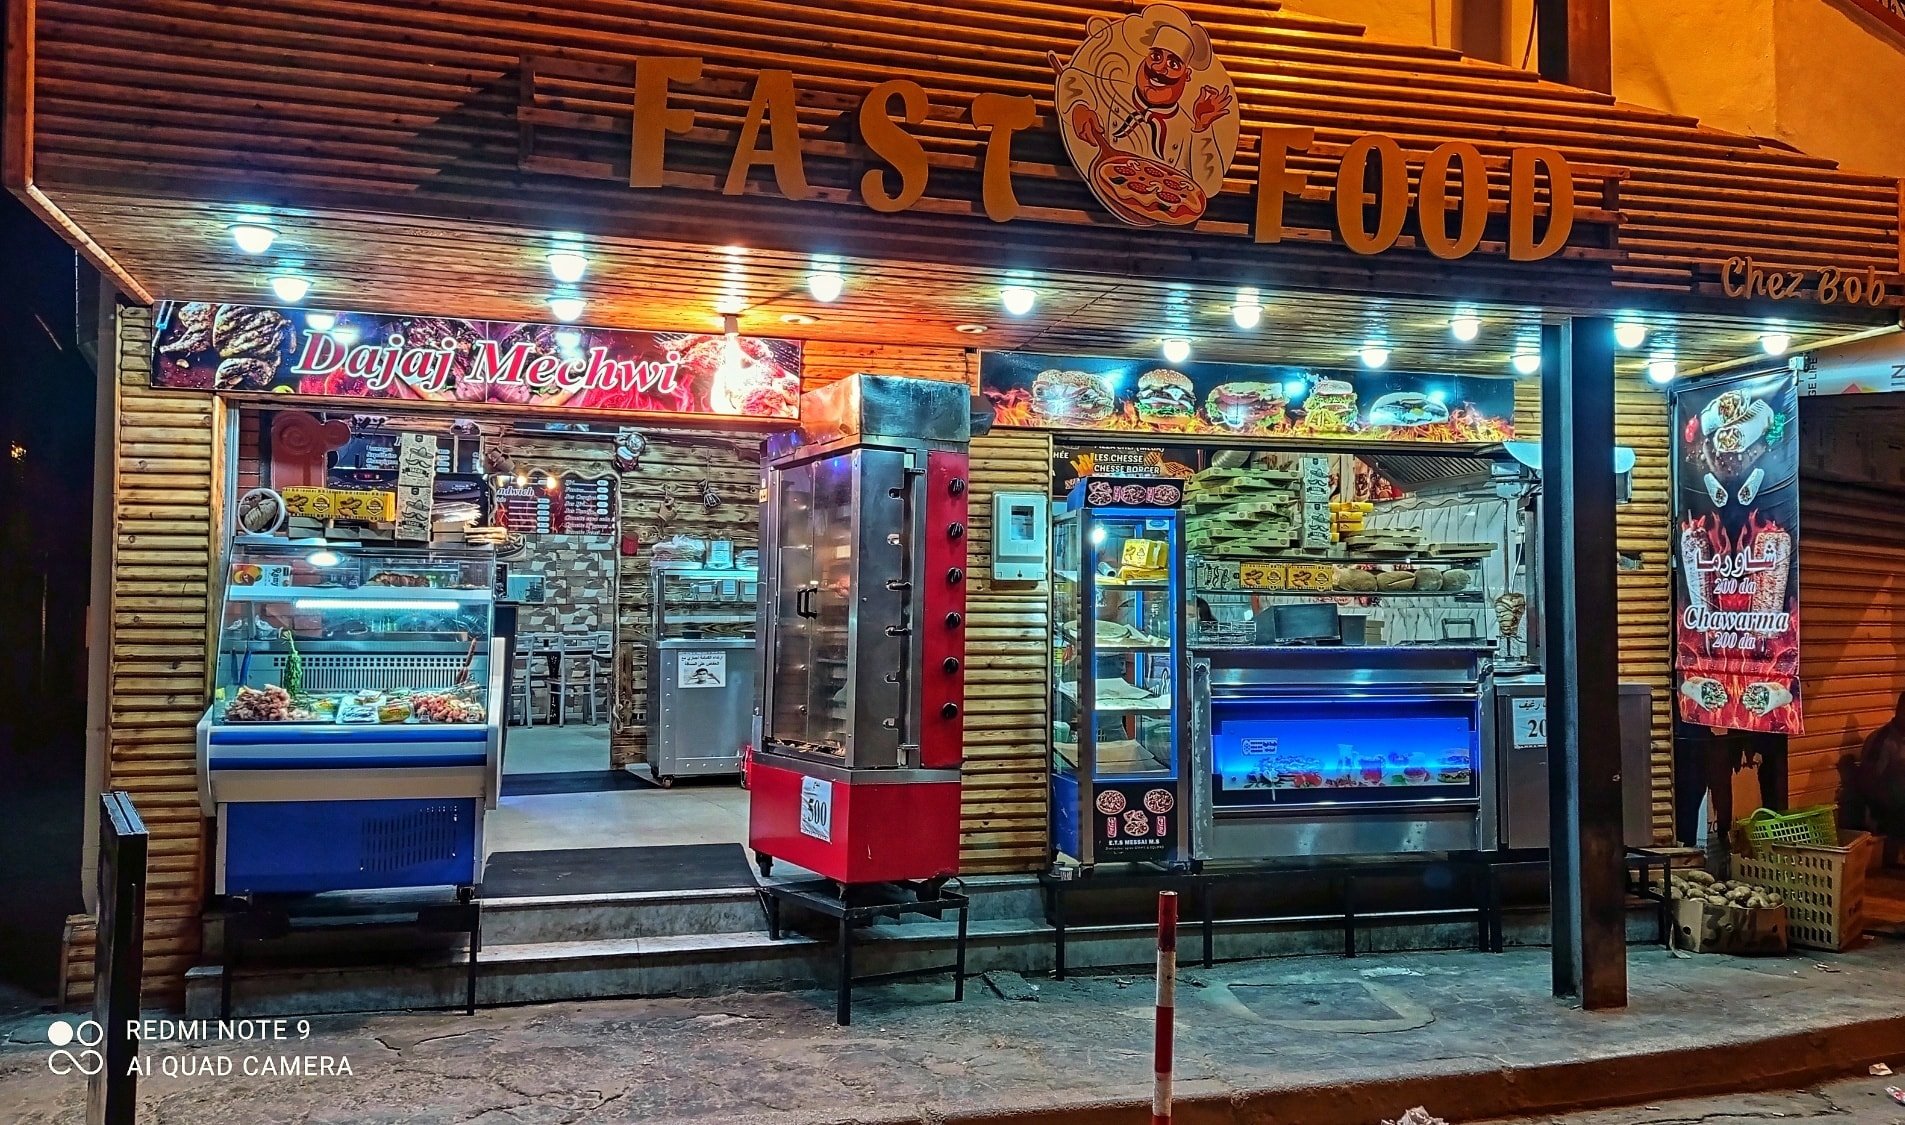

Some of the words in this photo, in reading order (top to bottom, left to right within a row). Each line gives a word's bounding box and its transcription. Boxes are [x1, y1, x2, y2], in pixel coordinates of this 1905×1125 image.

[629, 56, 1037, 222] FAST
[1254, 127, 1575, 261] FOOD
[1721, 256, 1804, 300] Chez
[1817, 265, 1885, 306] Bob
[290, 329, 457, 392] Dajaj
[464, 339, 682, 394] Mechwi
[1094, 453, 1109, 462] LES
[1111, 454, 1143, 463] CHESSE
[1696, 541, 1777, 578] شاورما
[1713, 578, 1737, 594] 200
[1739, 578, 1756, 594] da
[1684, 605, 1789, 632] Chawarma
[1712, 631, 1737, 648] 200
[1739, 632, 1756, 649] da
[807, 798, 827, 826] 500
